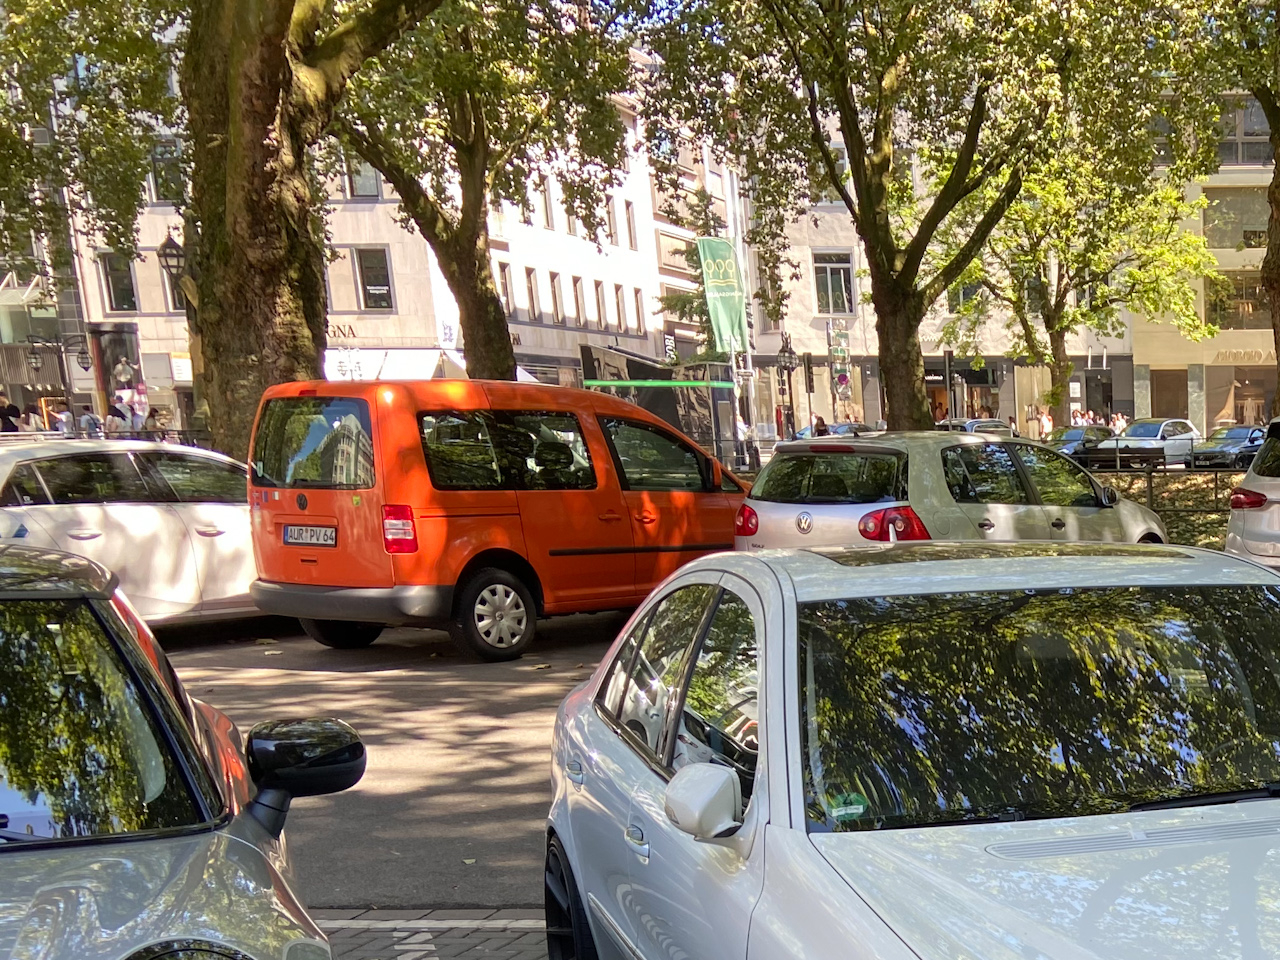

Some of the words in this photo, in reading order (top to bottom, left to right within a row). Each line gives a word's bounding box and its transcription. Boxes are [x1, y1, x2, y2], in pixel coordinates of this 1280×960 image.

[288, 527, 304, 541] AUR
[309, 528, 322, 542] PV
[323, 529, 334, 542] 64
